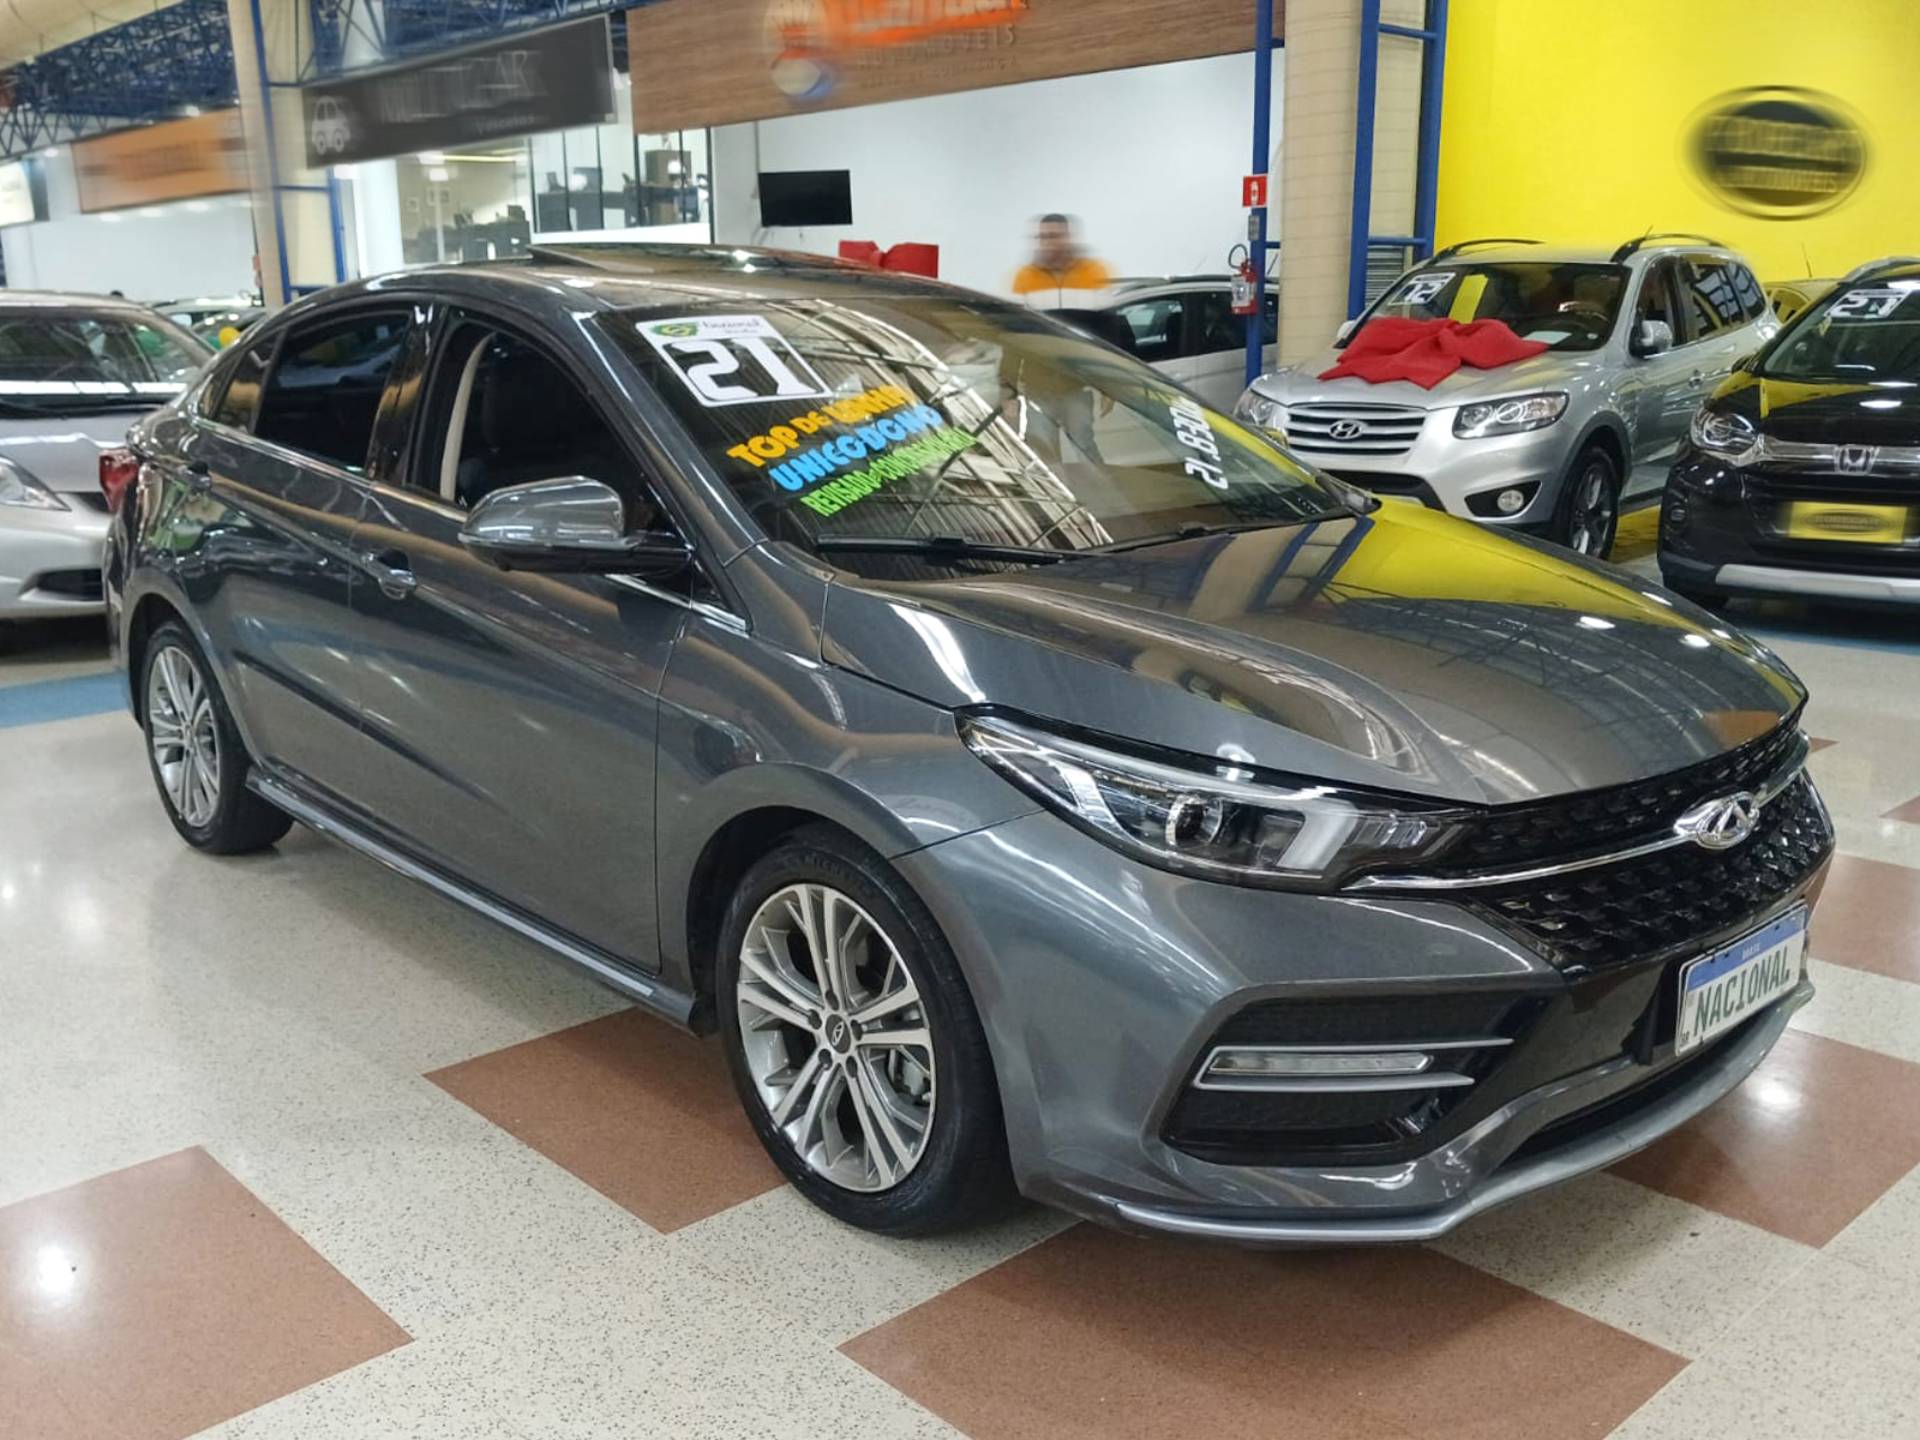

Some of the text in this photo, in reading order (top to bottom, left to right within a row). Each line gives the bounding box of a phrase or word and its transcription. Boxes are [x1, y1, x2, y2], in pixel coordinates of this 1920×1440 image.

[670, 337, 818, 401] 21
[726, 424, 801, 469] TOP
[790, 409, 835, 435] DE
[799, 470, 882, 518] REVISADO
[1693, 944, 1791, 1038] NACIONAL
